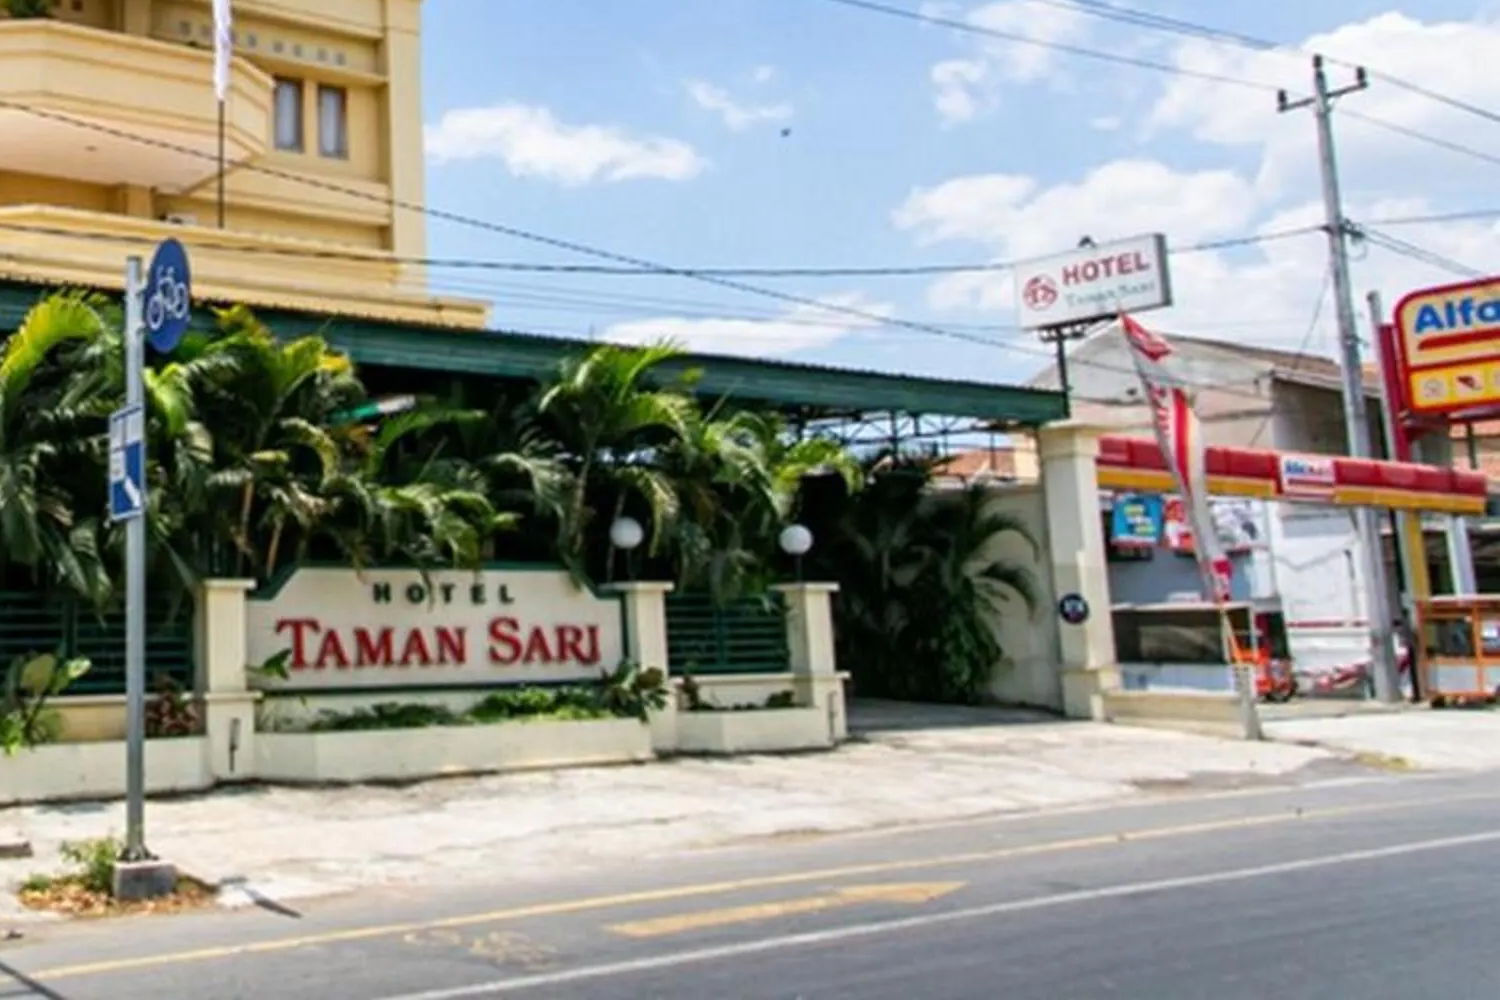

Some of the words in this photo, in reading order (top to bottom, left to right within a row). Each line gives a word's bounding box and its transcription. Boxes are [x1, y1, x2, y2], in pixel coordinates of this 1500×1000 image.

[1062, 252, 1149, 286] HOTEL
[372, 581, 515, 604] HOTEL
[276, 617, 468, 671] TAMAN
[487, 616, 600, 665] SARI
